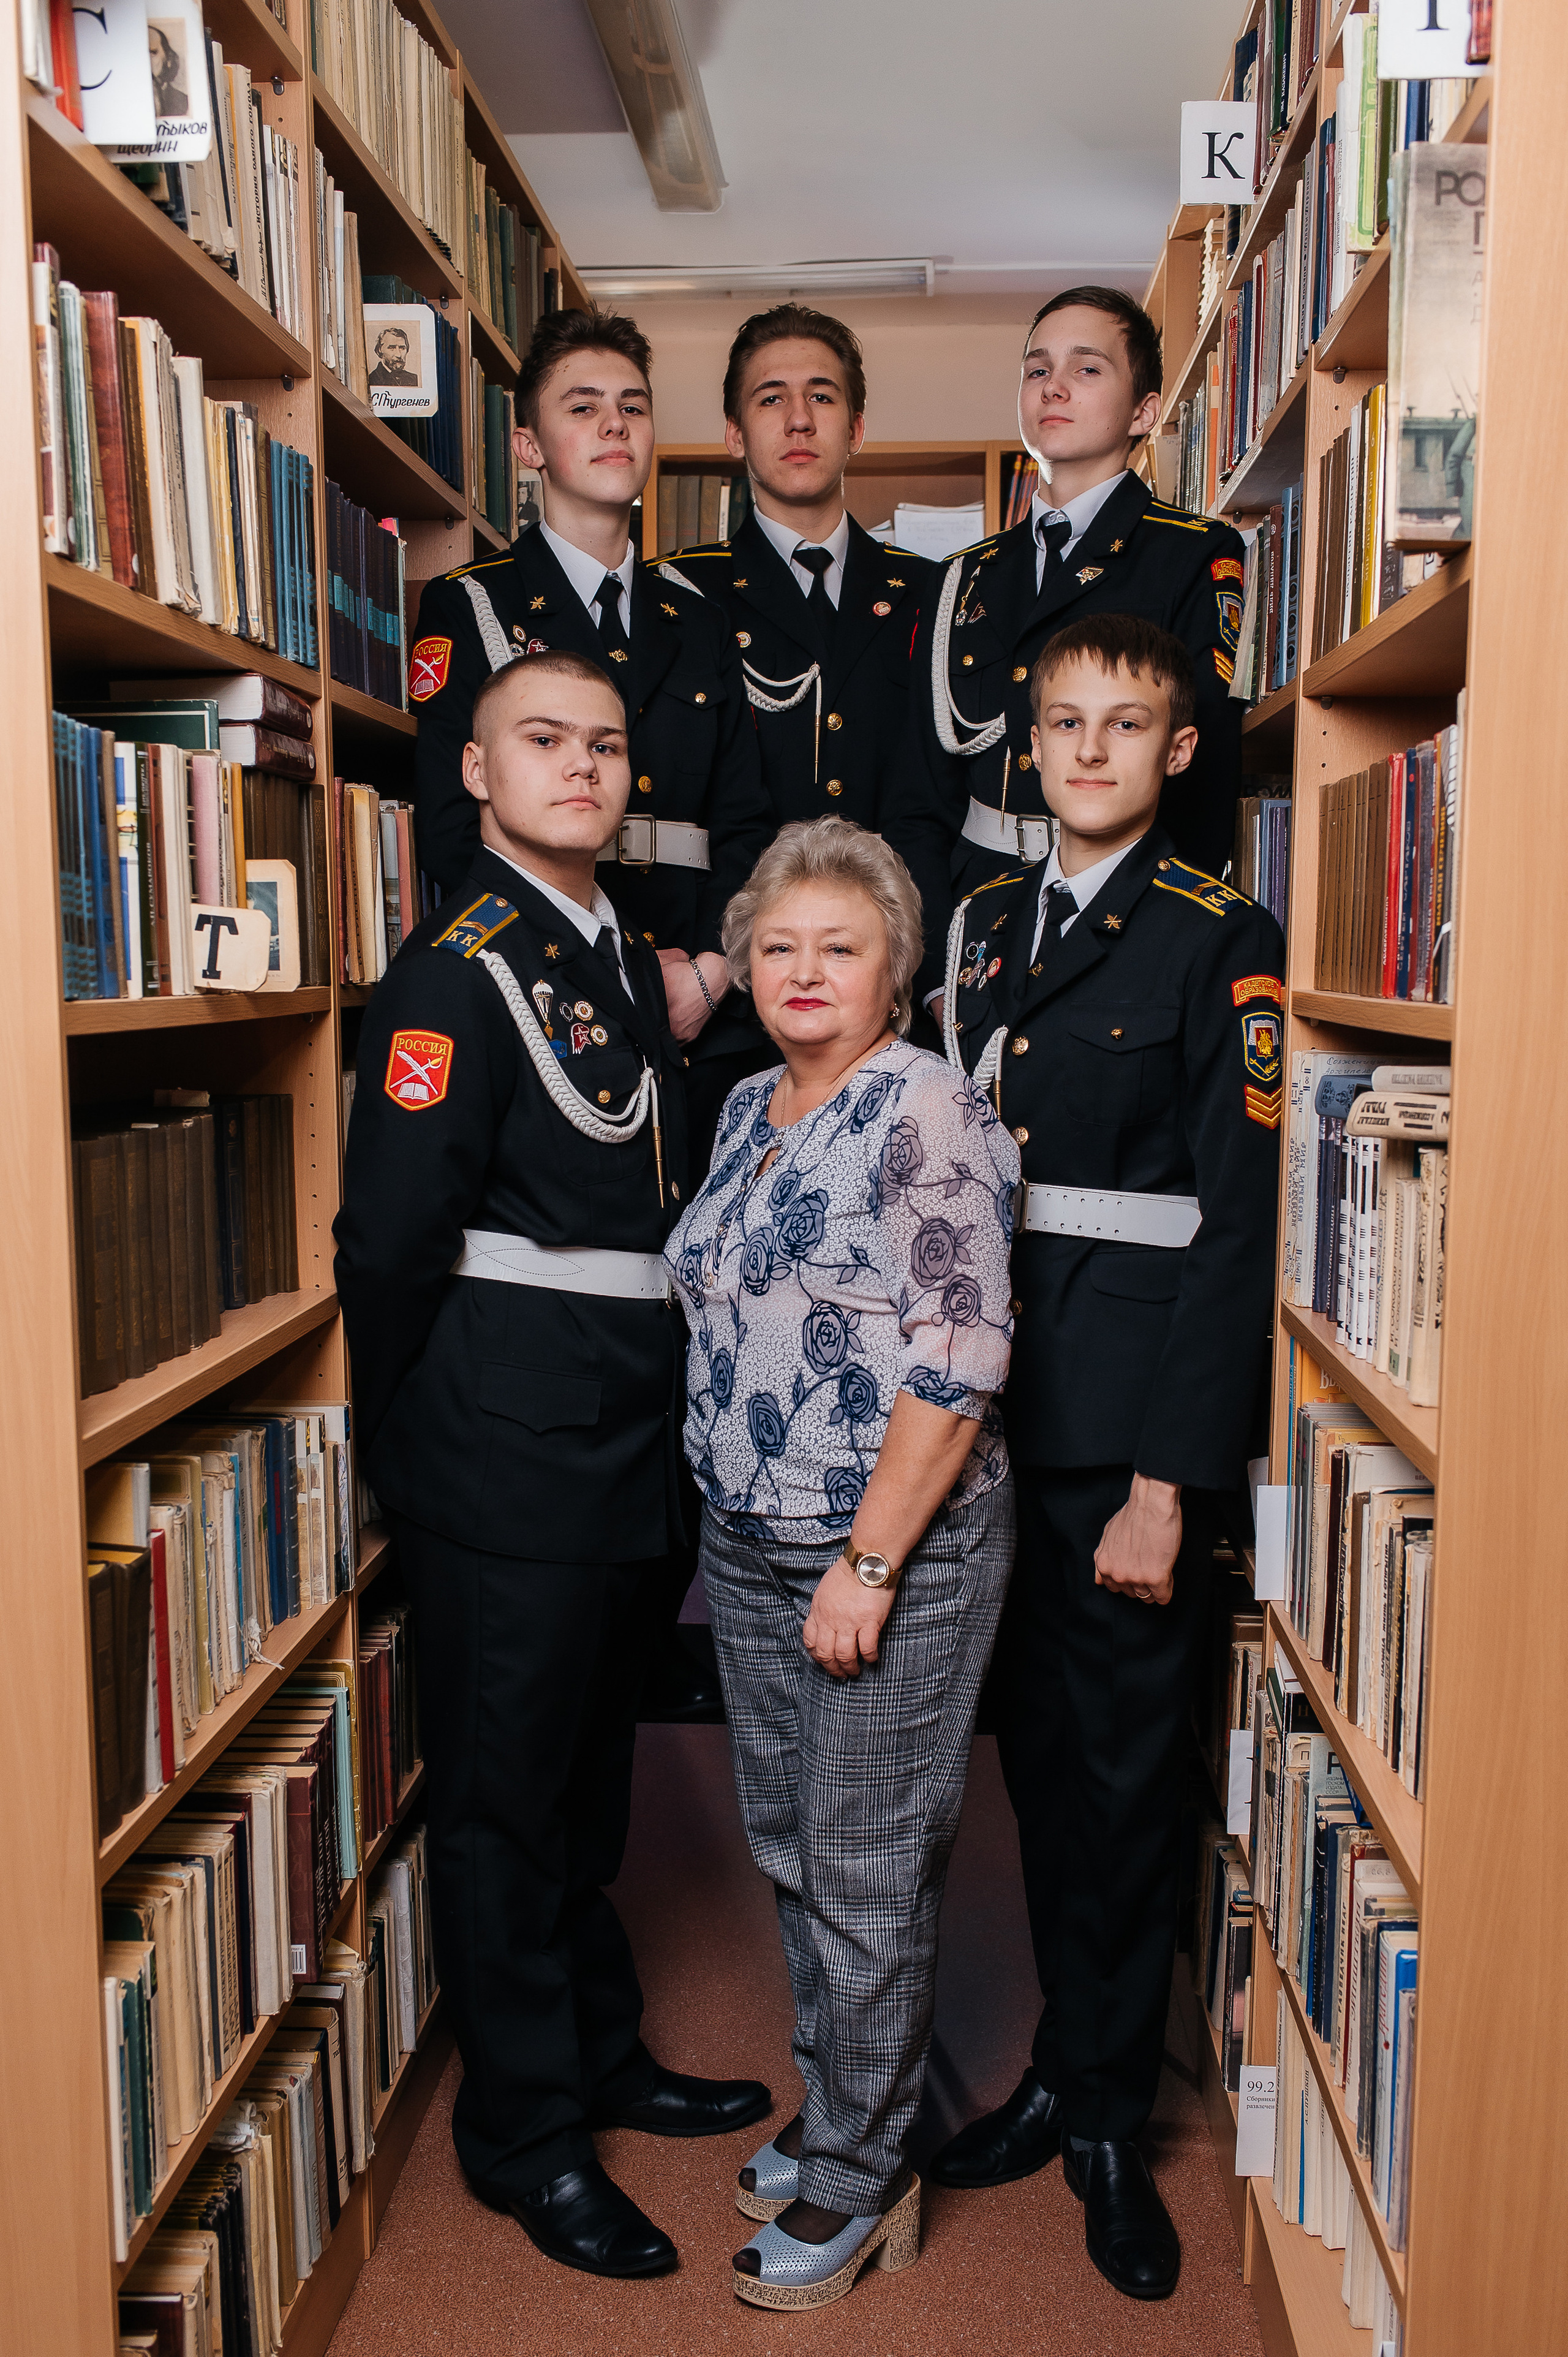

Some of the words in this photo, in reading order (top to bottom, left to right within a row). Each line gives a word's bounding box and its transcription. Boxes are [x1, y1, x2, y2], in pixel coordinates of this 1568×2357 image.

[1201, 131, 1246, 180] К
[195, 914, 238, 979] Т
[1240, 986, 1278, 996] ОБРАЗОВАНИЕ
[1243, 980, 1275, 988] КАДЕТСКОЕ
[396, 1037, 447, 1055] РОССИЯ
[1305, 1076, 1310, 1084] 8
[1350, 1901, 1360, 2021] ЭЙНШТЕЙН
[1247, 2081, 1275, 2092] 99.2
